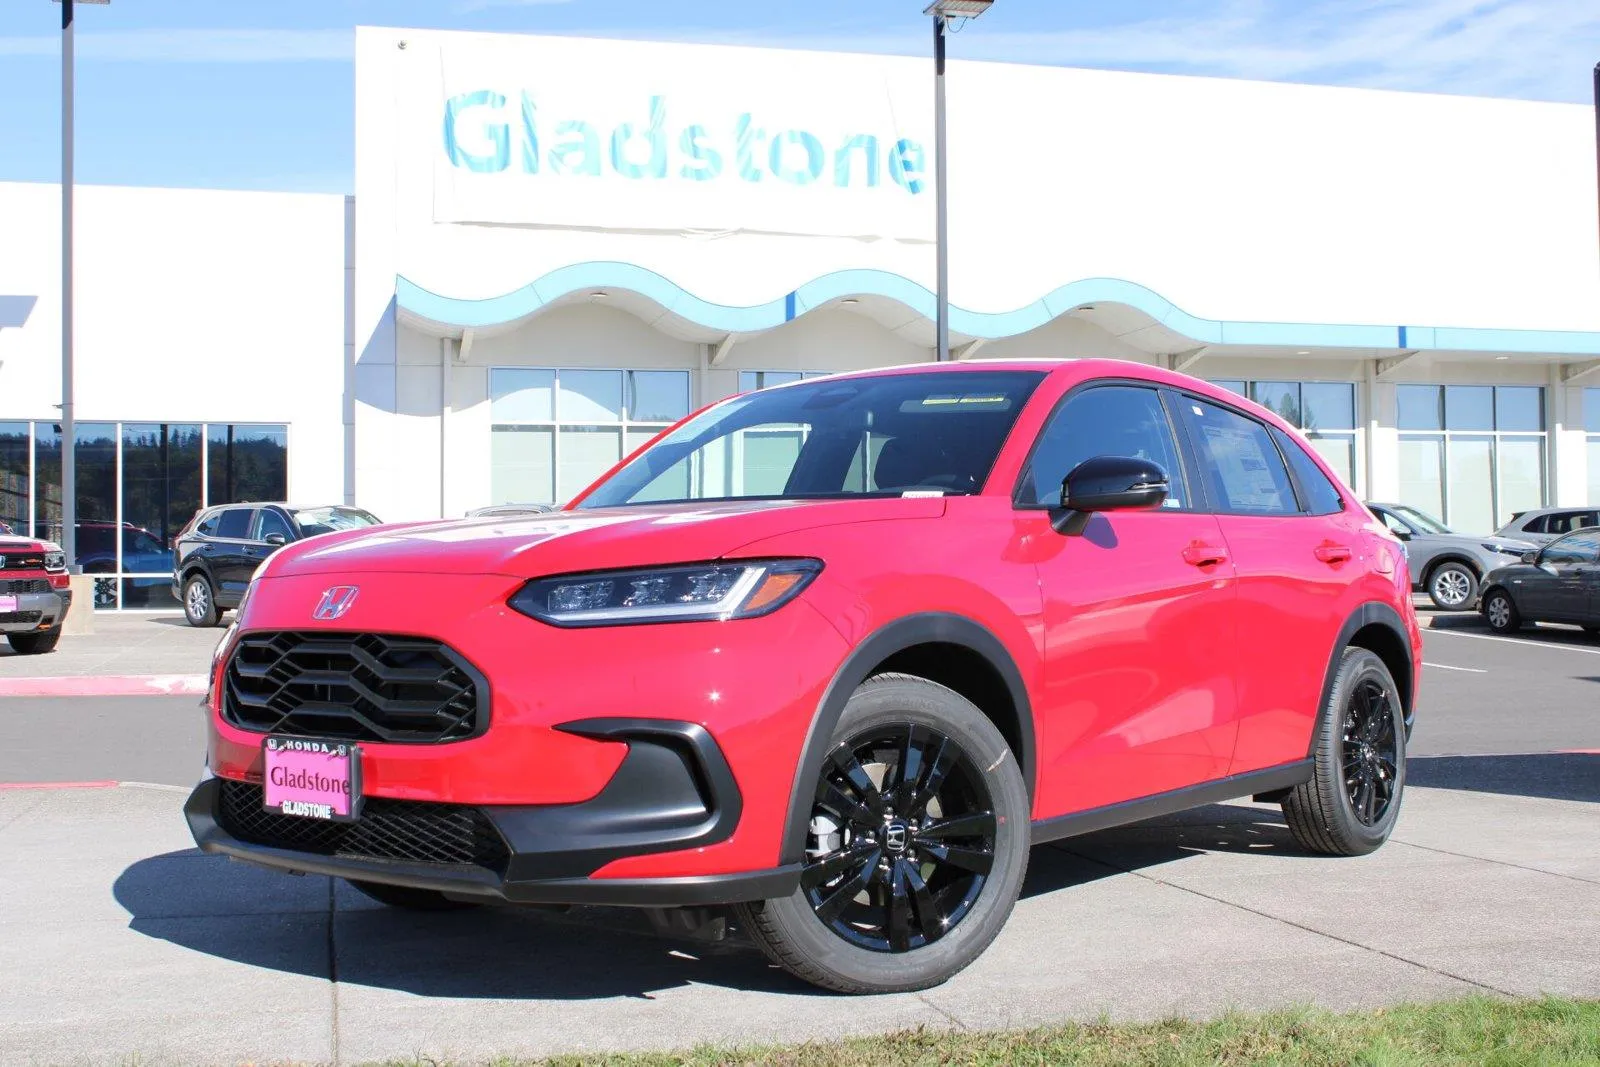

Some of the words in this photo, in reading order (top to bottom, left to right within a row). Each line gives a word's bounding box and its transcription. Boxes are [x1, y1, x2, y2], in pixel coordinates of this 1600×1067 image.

[443, 89, 926, 196] Gladstone
[285, 740, 329, 753] HONDA
[270, 766, 350, 796] Gladstone
[282, 799, 332, 819] GLADSTONE
